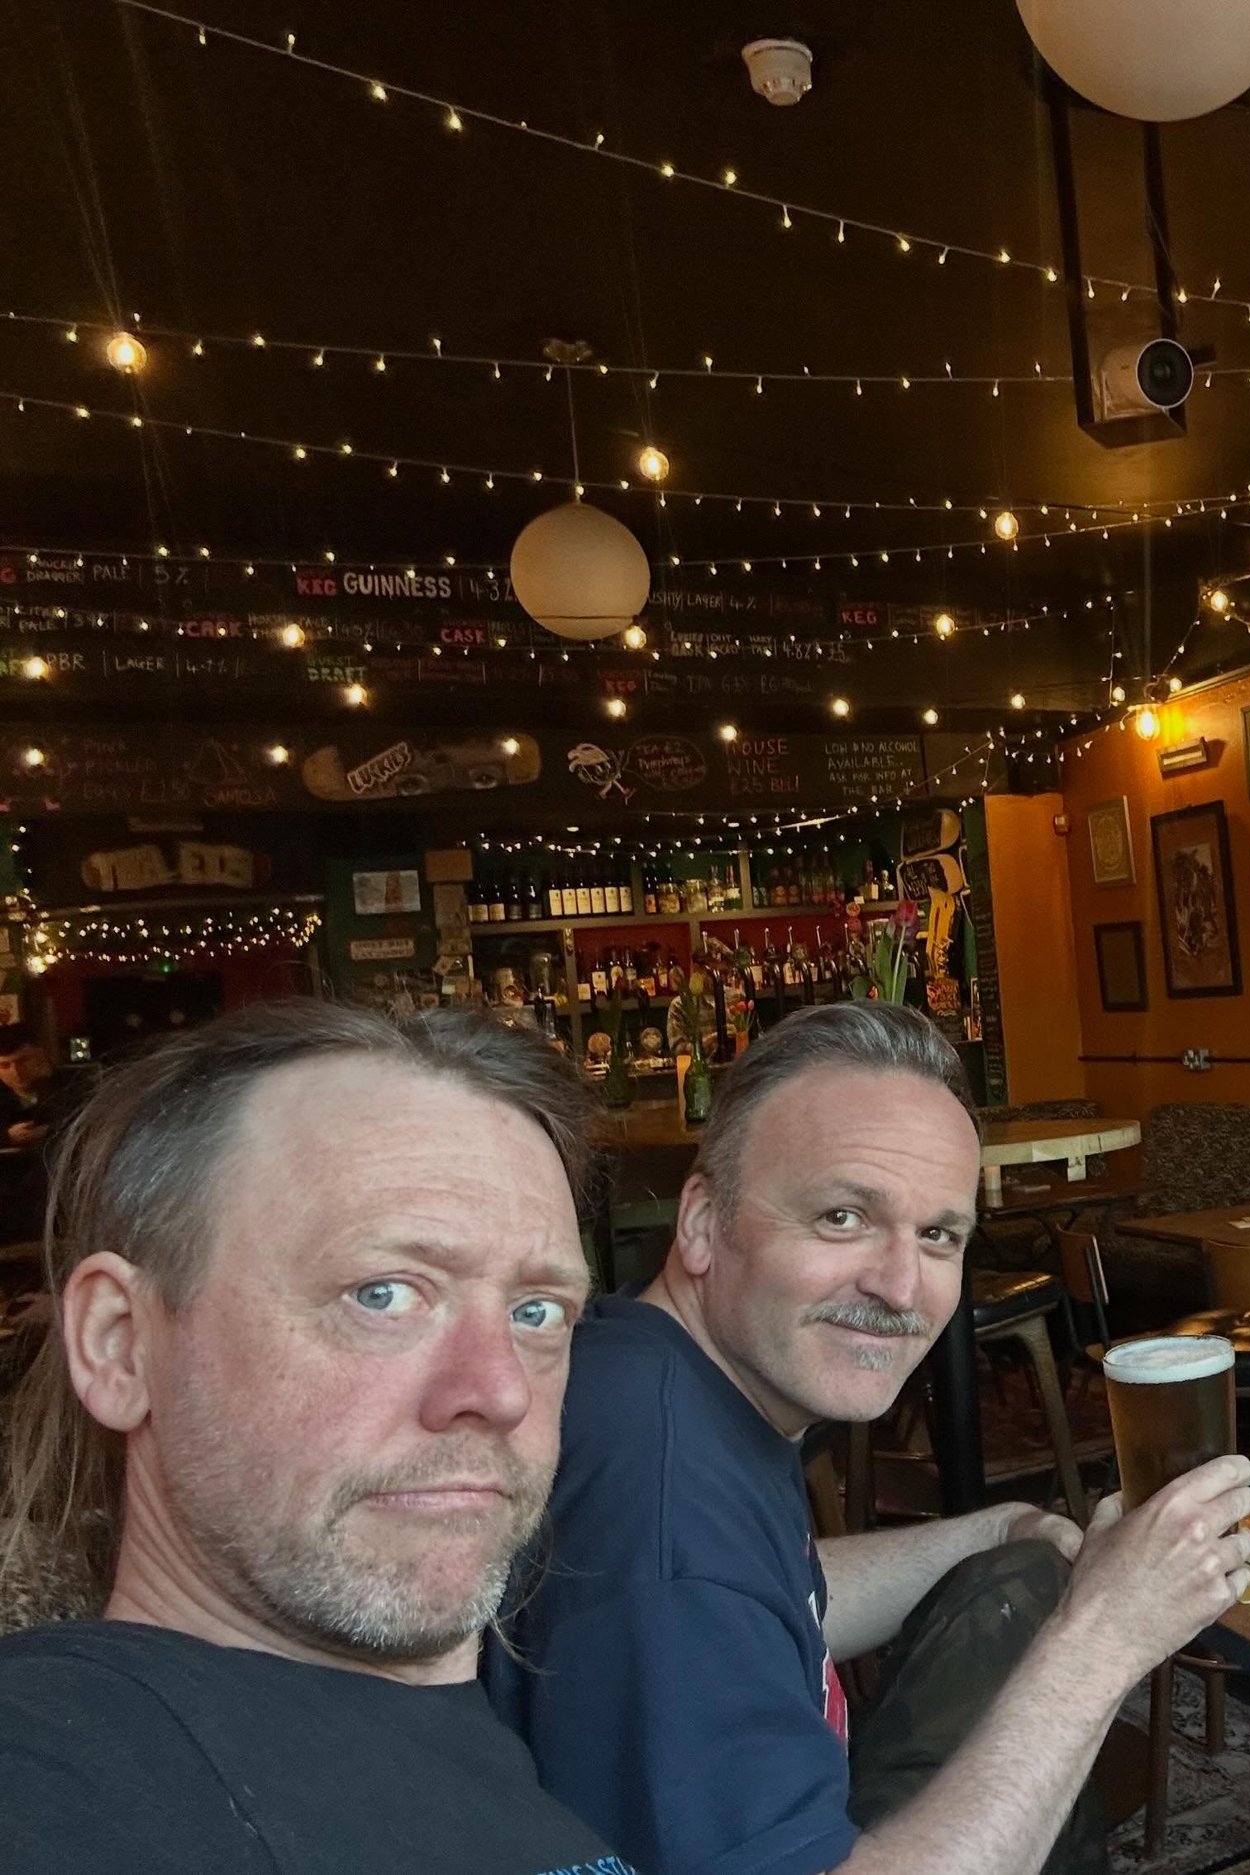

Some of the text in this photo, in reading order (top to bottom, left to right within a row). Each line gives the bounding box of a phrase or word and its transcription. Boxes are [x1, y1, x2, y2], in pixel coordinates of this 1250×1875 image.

[93, 563, 130, 582] PALE
[298, 577, 337, 596] KEG
[343, 571, 452, 599] GUINNESS
[687, 593, 722, 609] LAGER
[841, 610, 878, 625] KEG
[440, 627, 486, 645] CASK
[47, 652, 86, 671] PBR
[307, 666, 367, 683] DRAFT
[726, 737, 790, 756] HOUSE
[862, 741, 875, 753] NO
[879, 740, 919, 753] ALCOHOL
[349, 743, 411, 791] LUCKIES
[726, 756, 780, 776] WINE
[901, 768, 913, 778] AT
